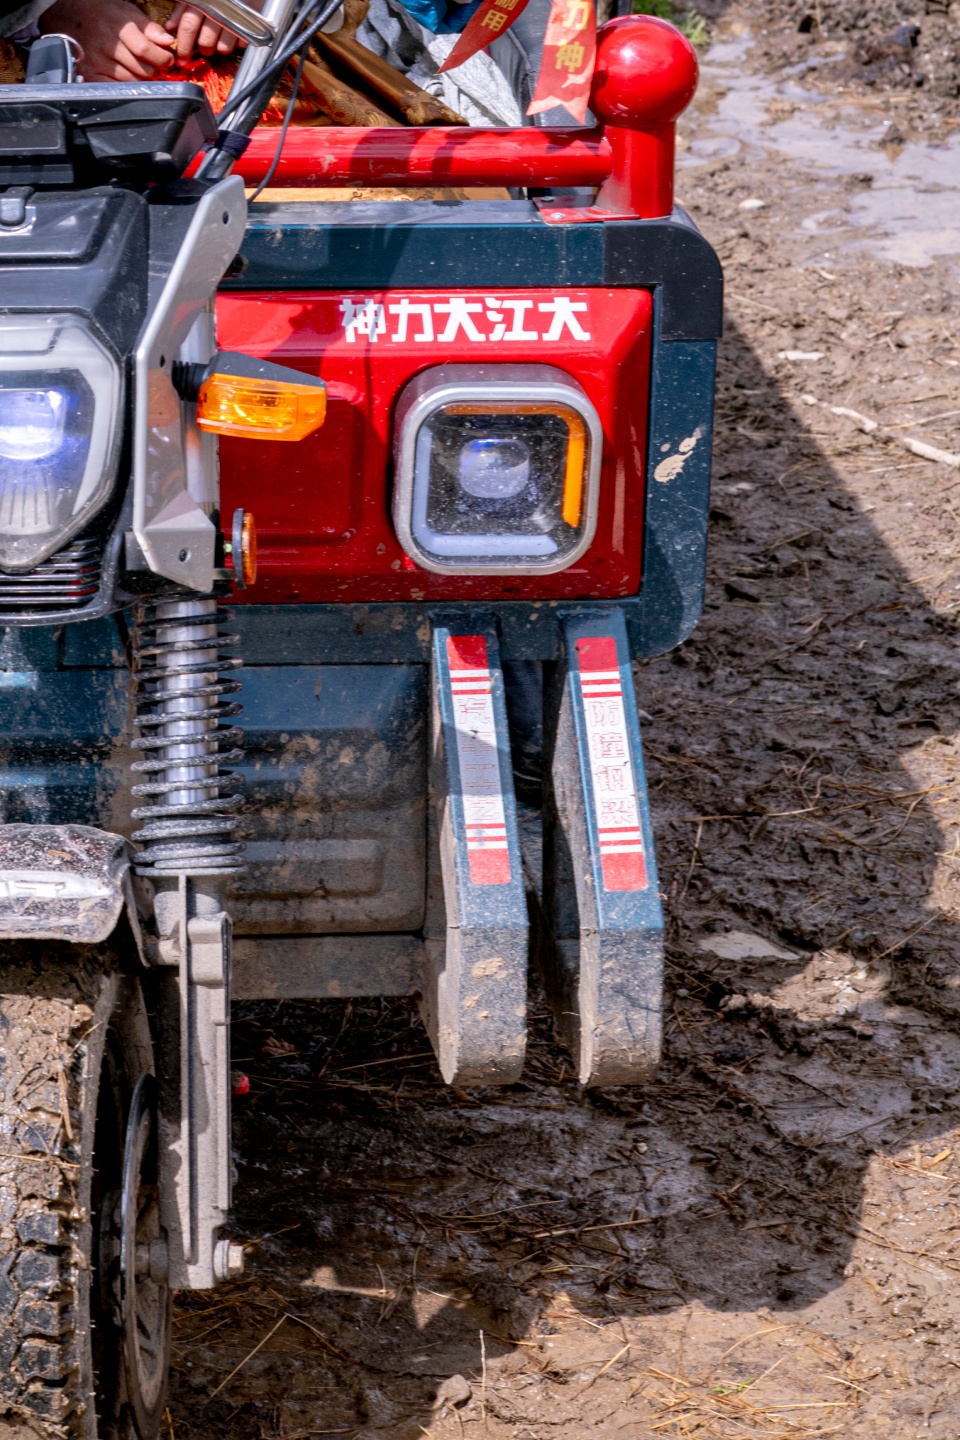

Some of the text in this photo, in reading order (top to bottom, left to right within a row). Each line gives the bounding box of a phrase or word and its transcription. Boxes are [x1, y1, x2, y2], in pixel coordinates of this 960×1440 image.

[457, 697, 500, 825] 汽车工艺
[588, 699, 635, 825] 防撞钢梁
